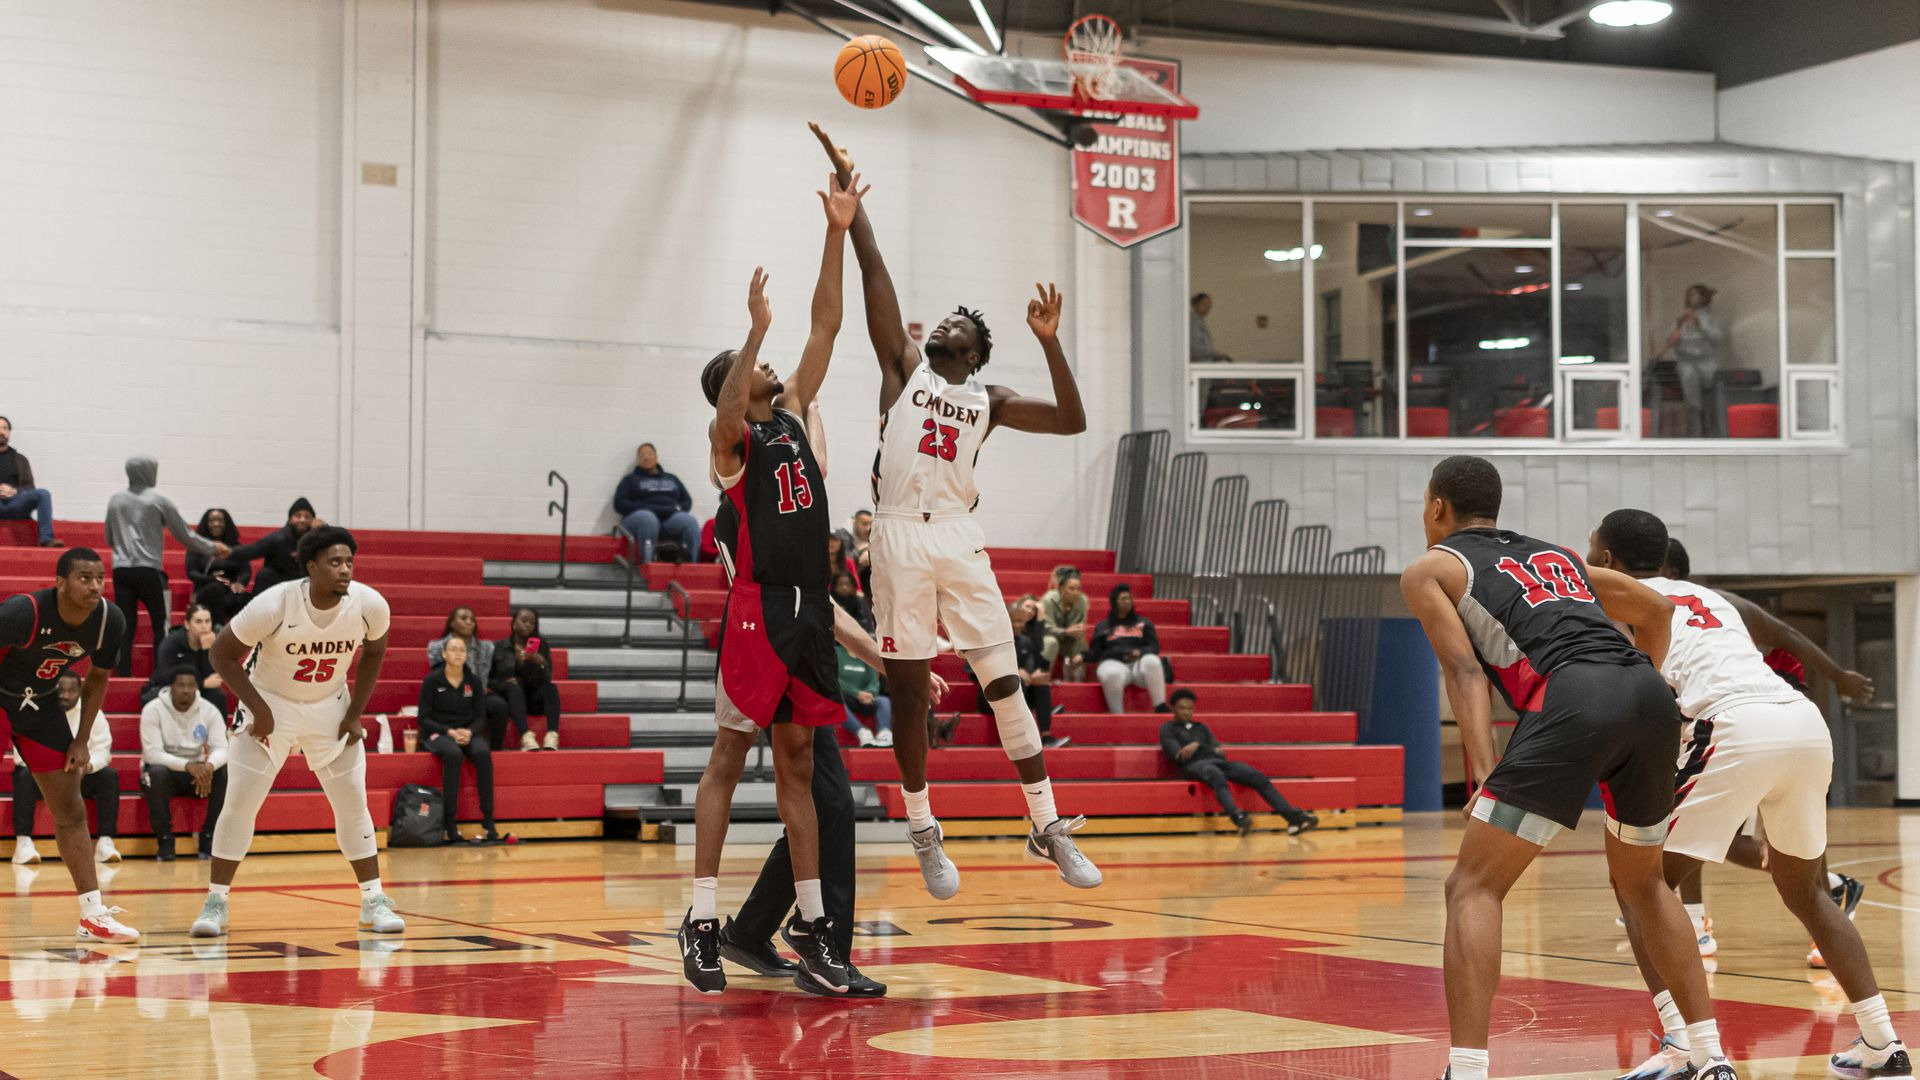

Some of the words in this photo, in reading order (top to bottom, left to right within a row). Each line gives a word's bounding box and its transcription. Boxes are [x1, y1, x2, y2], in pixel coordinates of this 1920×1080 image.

[1074, 134, 1171, 160] AMPIONS
[1090, 162, 1156, 192] 2003
[1107, 195, 1138, 229] R
[918, 418, 960, 462] 23
[774, 458, 813, 514] 15
[1495, 550, 1596, 608] 10
[285, 640, 355, 655] CAMDEN
[881, 636, 898, 653] R
[36, 658, 69, 679] 5
[292, 658, 338, 683] 25
